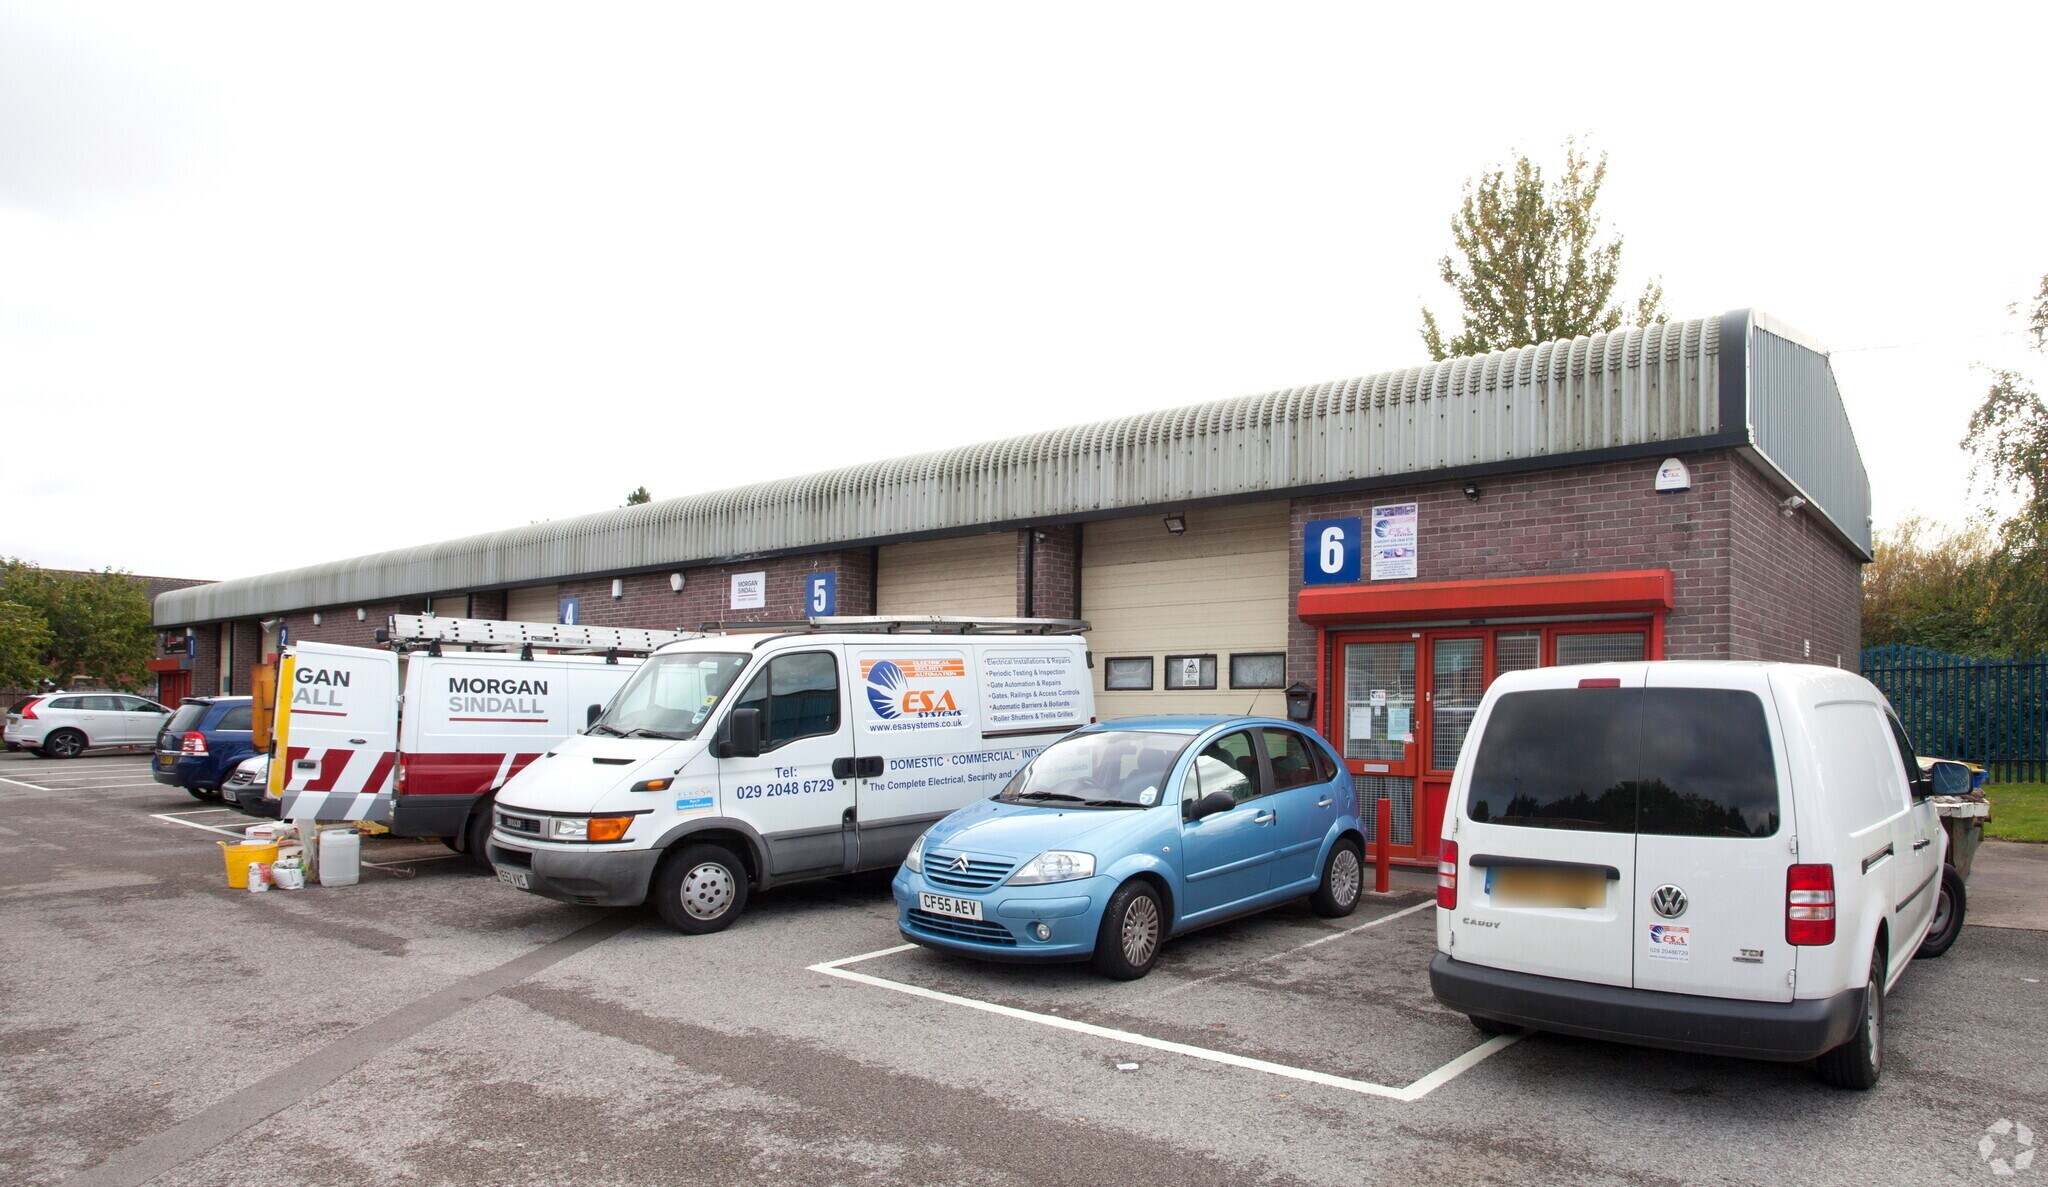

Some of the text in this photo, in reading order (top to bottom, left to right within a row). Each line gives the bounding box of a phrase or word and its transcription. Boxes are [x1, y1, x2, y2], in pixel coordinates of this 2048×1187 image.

[1320, 526, 1345, 574] 6
[813, 579, 826, 612] 5
[565, 603, 574, 625] 4
[281, 629, 287, 647] 2
[190, 639, 194, 656] 1
[987, 658, 1013, 666] Electrical
[1051, 657, 1071, 665] Repairs
[1012, 669, 1033, 677] Testing
[1039, 668, 1066, 676] Inspection
[449, 677, 548, 695] MORGAN
[1004, 680, 1036, 688] Automation
[1041, 679, 1062, 687] Repairs
[902, 690, 957, 713] ESA
[991, 692, 1009, 700] Gates,
[1010, 691, 1032, 699] Railings
[448, 696, 545, 714] SINDALL
[992, 703, 1020, 711] Automatic
[917, 710, 963, 718] SYSTEMS
[993, 714, 1010, 722] Roller
[1010, 713, 1034, 721] Shutters
[869, 719, 963, 732] www.esasystems.co.uk
[890, 756, 944, 771] DOMESTIC
[951, 751, 1016, 765] COMMERCIAL
[775, 766, 798, 778] Tel:
[869, 782, 886, 792] The
[887, 778, 926, 790] Complete
[928, 775, 966, 787] Electrical,
[967, 771, 997, 783] Security
[998, 769, 1012, 779] and
[736, 779, 834, 800] 029 2048 6729
[924, 894, 976, 916] CF55 AEV
[1462, 917, 1501, 929] CADDY
[1663, 935, 1685, 944] ESA
[1740, 948, 1764, 957] TDI
